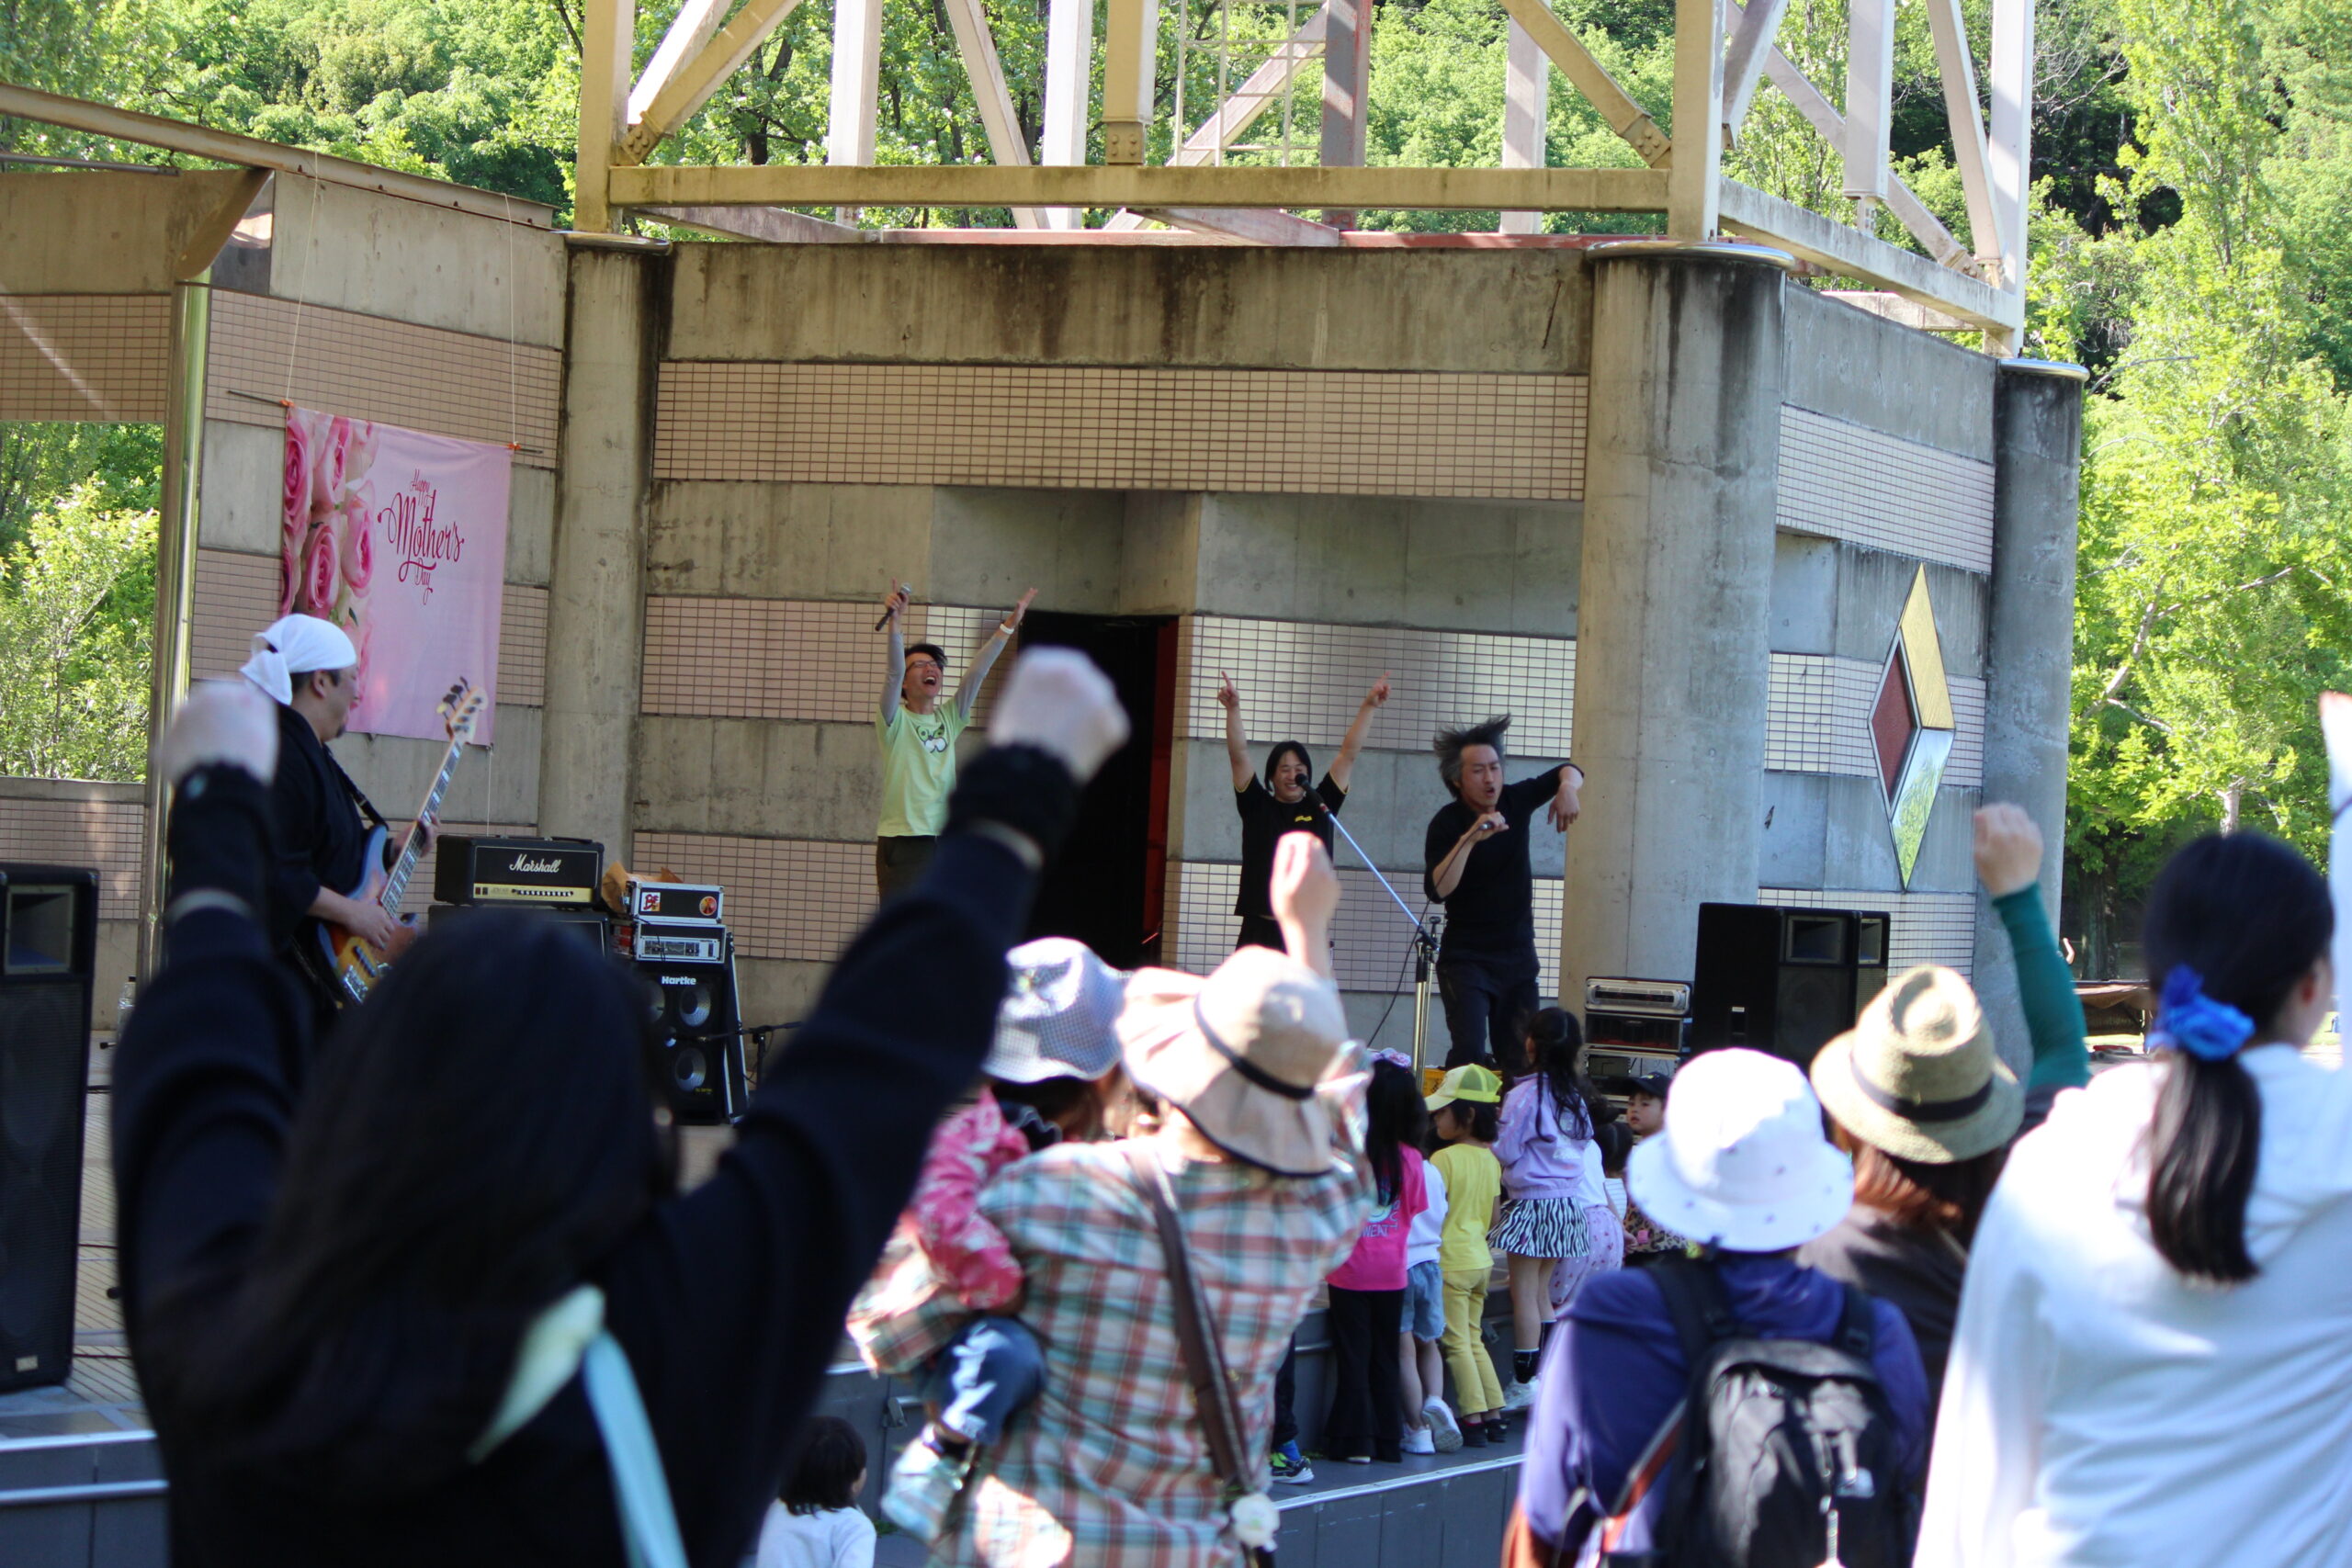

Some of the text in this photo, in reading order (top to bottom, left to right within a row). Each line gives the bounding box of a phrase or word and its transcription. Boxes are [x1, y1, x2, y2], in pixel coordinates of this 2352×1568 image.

[410, 468, 433, 507] Happy
[414, 558, 433, 605] Day
[509, 853, 561, 873] Marshall
[662, 976, 696, 985] Hartke
